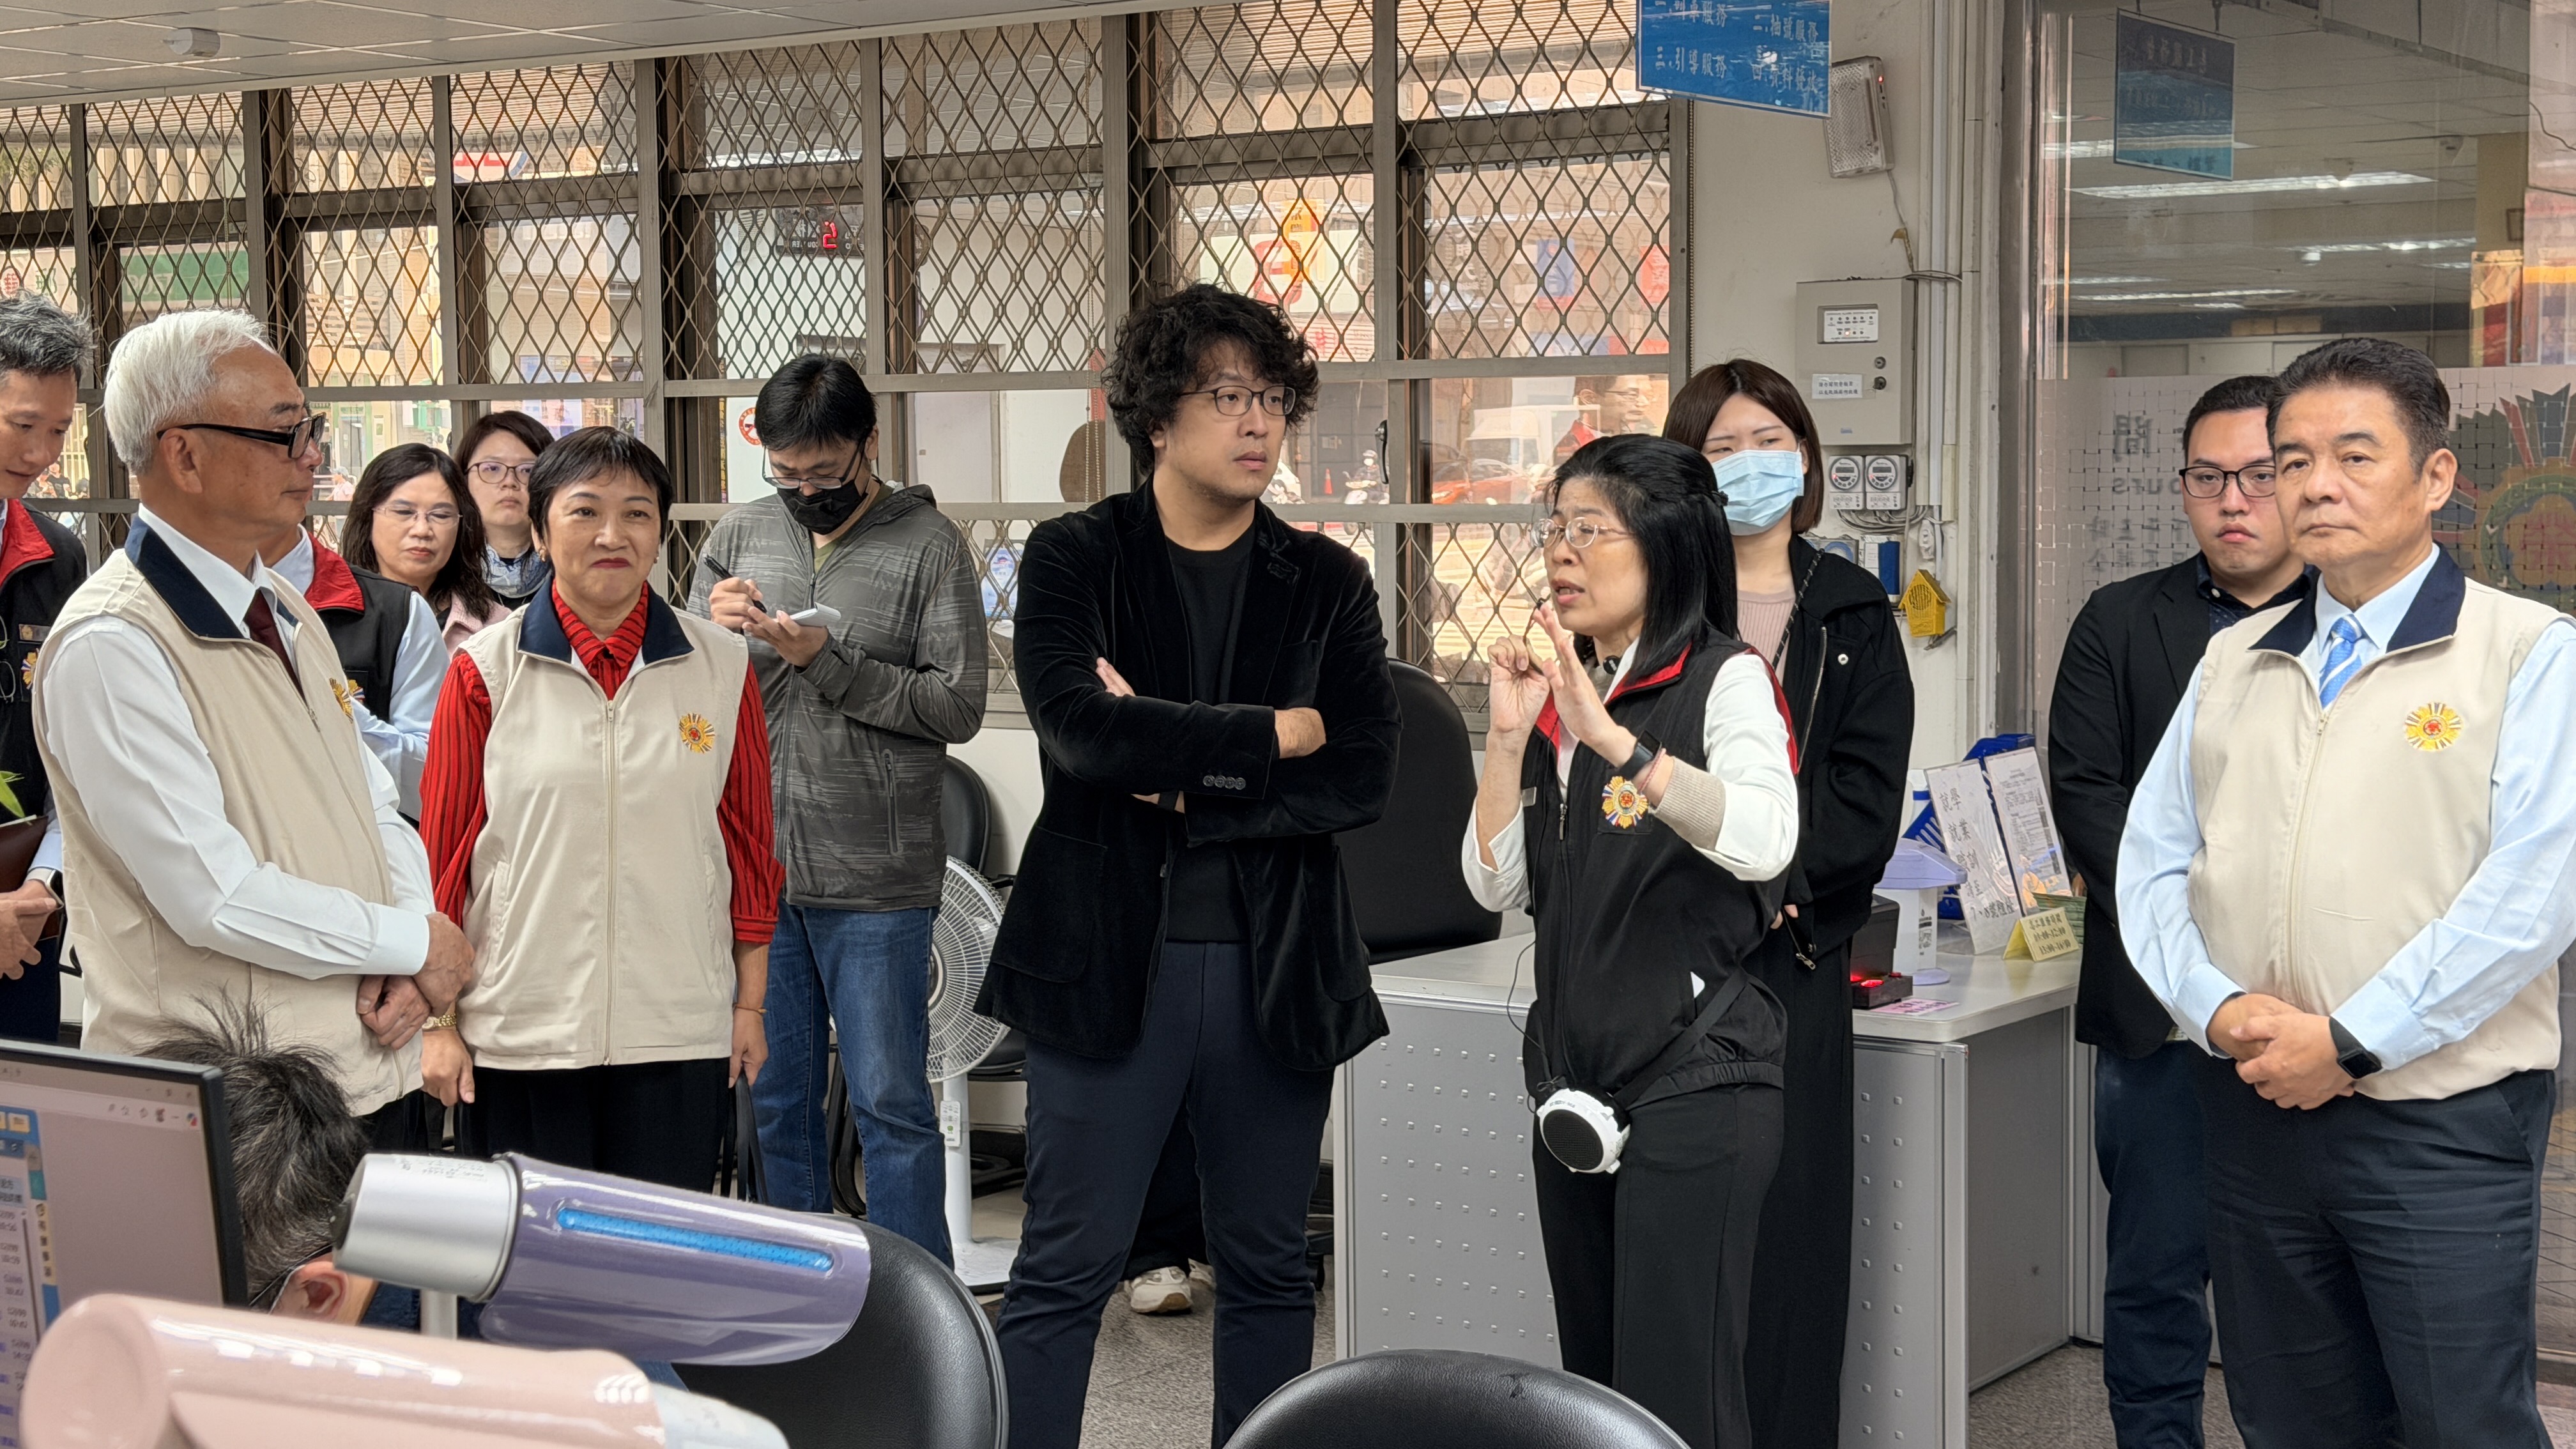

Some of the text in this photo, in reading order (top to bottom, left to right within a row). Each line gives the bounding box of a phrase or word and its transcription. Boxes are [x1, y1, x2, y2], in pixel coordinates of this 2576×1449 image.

[1655, 46, 1727, 79] 三、引導服務
